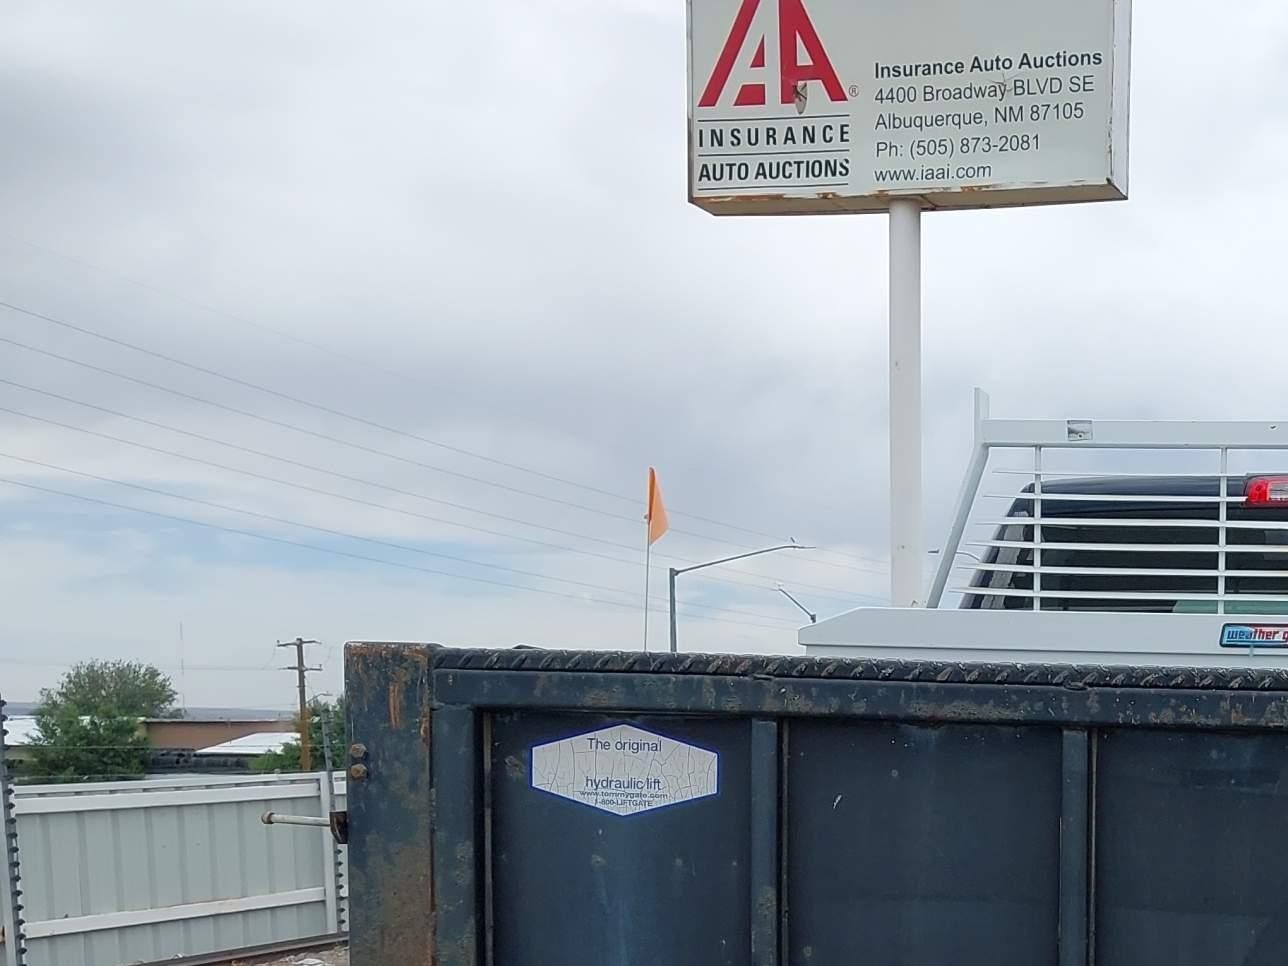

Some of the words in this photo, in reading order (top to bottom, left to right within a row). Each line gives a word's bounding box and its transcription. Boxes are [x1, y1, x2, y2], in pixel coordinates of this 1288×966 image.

[874, 61, 965, 79] Insurance
[970, 56, 1013, 73] Auto
[1018, 50, 1103, 70] Auctions
[874, 86, 917, 104] 4400
[923, 82, 1007, 102] Broadway
[1013, 77, 1063, 96] BLVD
[1068, 75, 1095, 92] SE
[875, 110, 988, 131] Albuquerque,
[994, 105, 1024, 123] NM
[1029, 102, 1084, 121] 87105
[698, 124, 850, 148] INSURANCE
[876, 140, 904, 158] Ph:
[909, 137, 955, 160] (505)
[960, 134, 1040, 154] 873-2081
[697, 162, 749, 182] AUTO
[754, 158, 850, 180] AUCTIONS
[874, 163, 992, 182] www.iaai.com
[587, 737, 611, 751] The
[615, 738, 662, 753] original
[585, 775, 644, 790] hydraulic
[646, 776, 661, 791] lift
